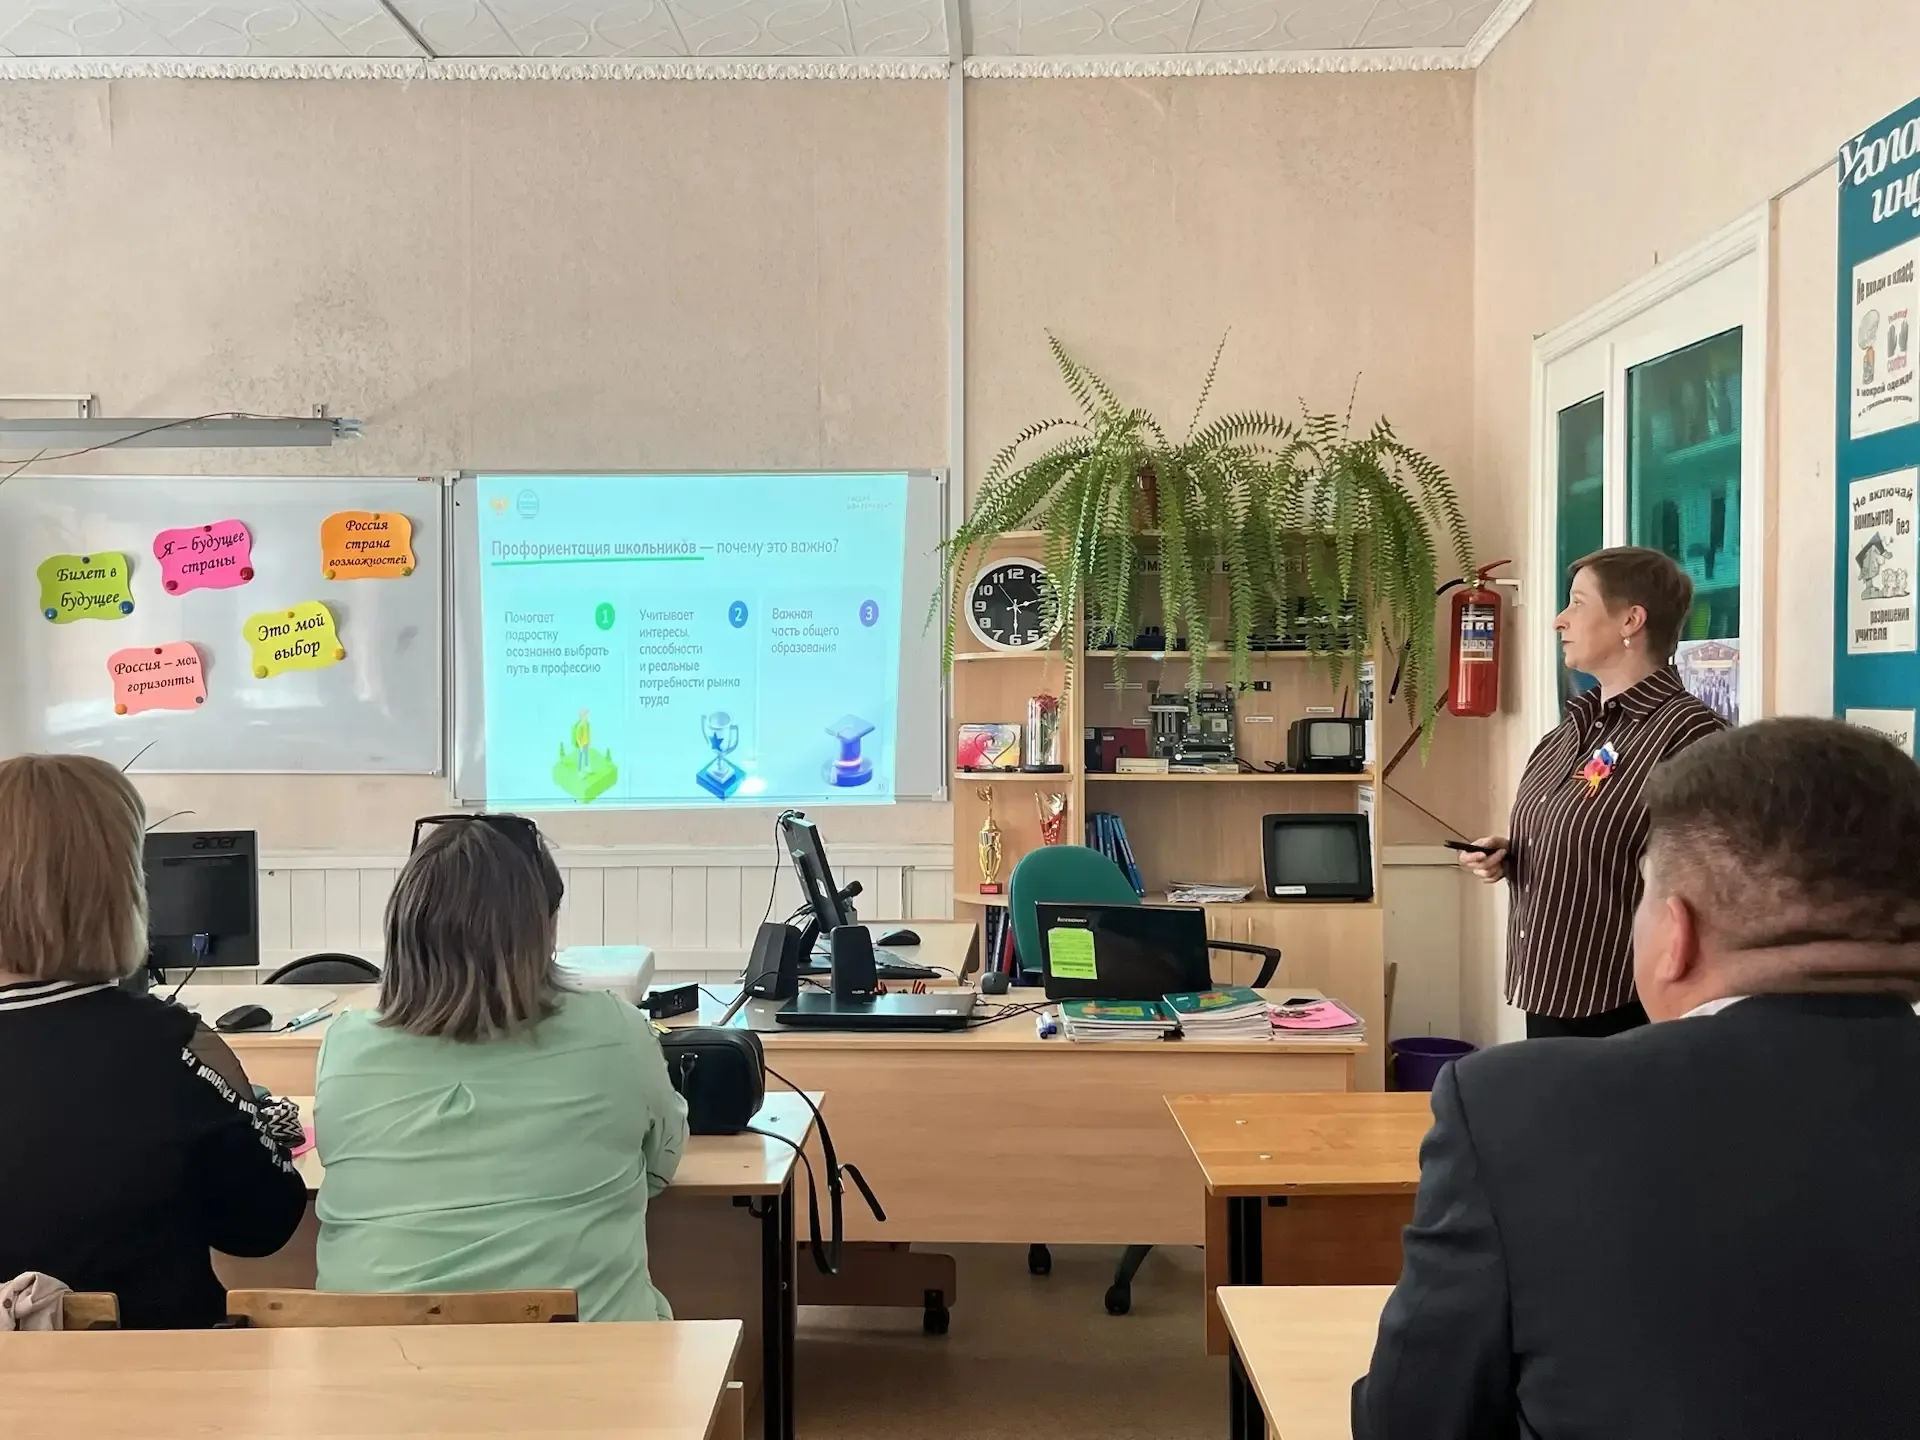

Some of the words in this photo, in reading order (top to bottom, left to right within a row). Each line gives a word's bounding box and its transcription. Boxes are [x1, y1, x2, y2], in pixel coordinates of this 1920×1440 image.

[1853, 496, 1866, 512] Не
[1869, 487, 1913, 501] включай
[345, 520, 389, 531] Россия
[1854, 508, 1894, 531] компьютер
[1896, 517, 1910, 536] без
[158, 541, 175, 559] Я
[191, 532, 245, 554] будущее
[345, 540, 390, 552] страна
[491, 540, 610, 560] Профориентация
[614, 541, 697, 555] школьников
[717, 541, 764, 557] почему
[767, 541, 788, 553] это
[791, 538, 839, 553] важно?
[181, 556, 236, 575] страны
[329, 555, 407, 567] возможностей
[56, 568, 106, 581] Билет
[110, 568, 117, 577] в
[992, 572, 1004, 584] 11
[1007, 568, 1025, 580] 12
[978, 585, 993, 596] 10
[61, 591, 120, 611] будущее
[974, 601, 987, 612] 9
[504, 610, 555, 624] Помогает
[601, 609, 609, 624] 1
[639, 608, 695, 621] Учитывает
[734, 607, 743, 622] 2
[772, 607, 813, 620] Важная
[865, 605, 873, 620] 3
[258, 624, 290, 641] Это
[295, 613, 325, 632] мой
[771, 626, 801, 637] часть
[802, 623, 840, 637] общего
[979, 617, 992, 629] 8
[505, 630, 559, 643] подростку
[992, 630, 1004, 641] 7
[1009, 634, 1022, 645] 6
[1027, 629, 1040, 641] 5
[1855, 627, 1888, 643] учителя
[274, 639, 321, 660] выбор
[506, 647, 562, 657] осознанно
[564, 644, 610, 659] выбрать
[639, 642, 703, 655] способности
[771, 641, 837, 656] образования
[115, 660, 161, 675] Россия
[176, 657, 197, 667] мои
[506, 664, 530, 677] путь
[532, 664, 539, 673] в
[541, 661, 601, 676] профессию
[639, 662, 646, 671] и
[648, 661, 701, 674] реальные
[127, 676, 195, 694] горизонты
[639, 676, 705, 691] потребности
[707, 678, 741, 691] рынка
[639, 695, 670, 708] труда
[193, 836, 243, 850] acer
